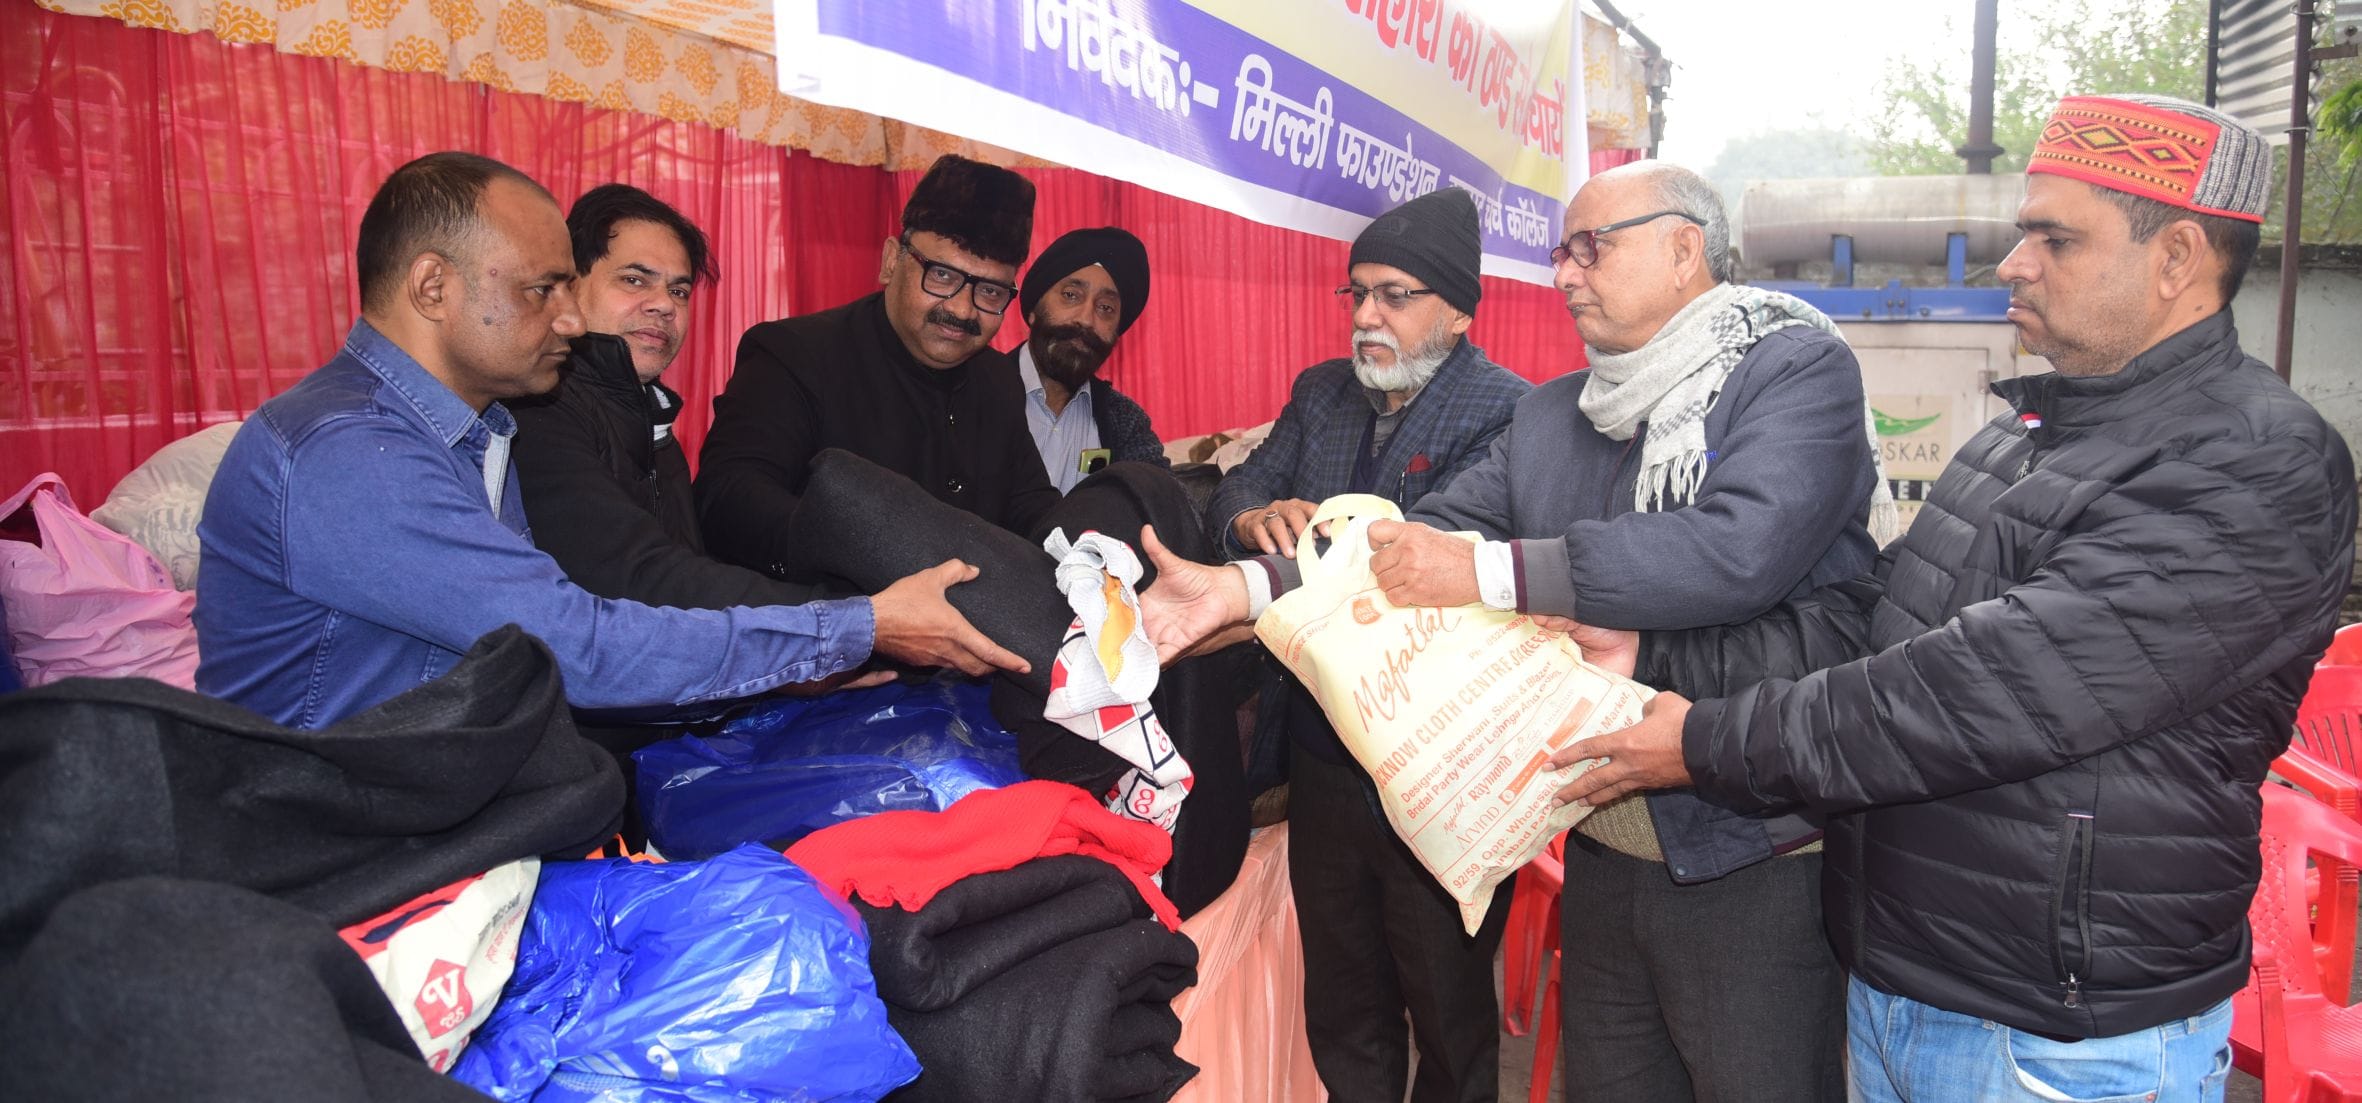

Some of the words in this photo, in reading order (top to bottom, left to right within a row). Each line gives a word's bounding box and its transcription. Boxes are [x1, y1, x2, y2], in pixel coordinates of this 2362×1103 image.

[1230, 54, 1334, 170] मिल्ली
[1505, 197, 1549, 248] कॉलेज
[1415, 698, 1462, 745] CLOTH
[1458, 656, 1512, 705] CENTRE
[1400, 760, 1443, 804] Designer
[1442, 717, 1490, 764] Sherwani
[1406, 792, 1434, 820] Bridal
[1431, 768, 1460, 796] Party
[1456, 741, 1486, 770] Wear
[1483, 709, 1521, 745] Lehnga
[1506, 779, 1559, 835] Wholesale
